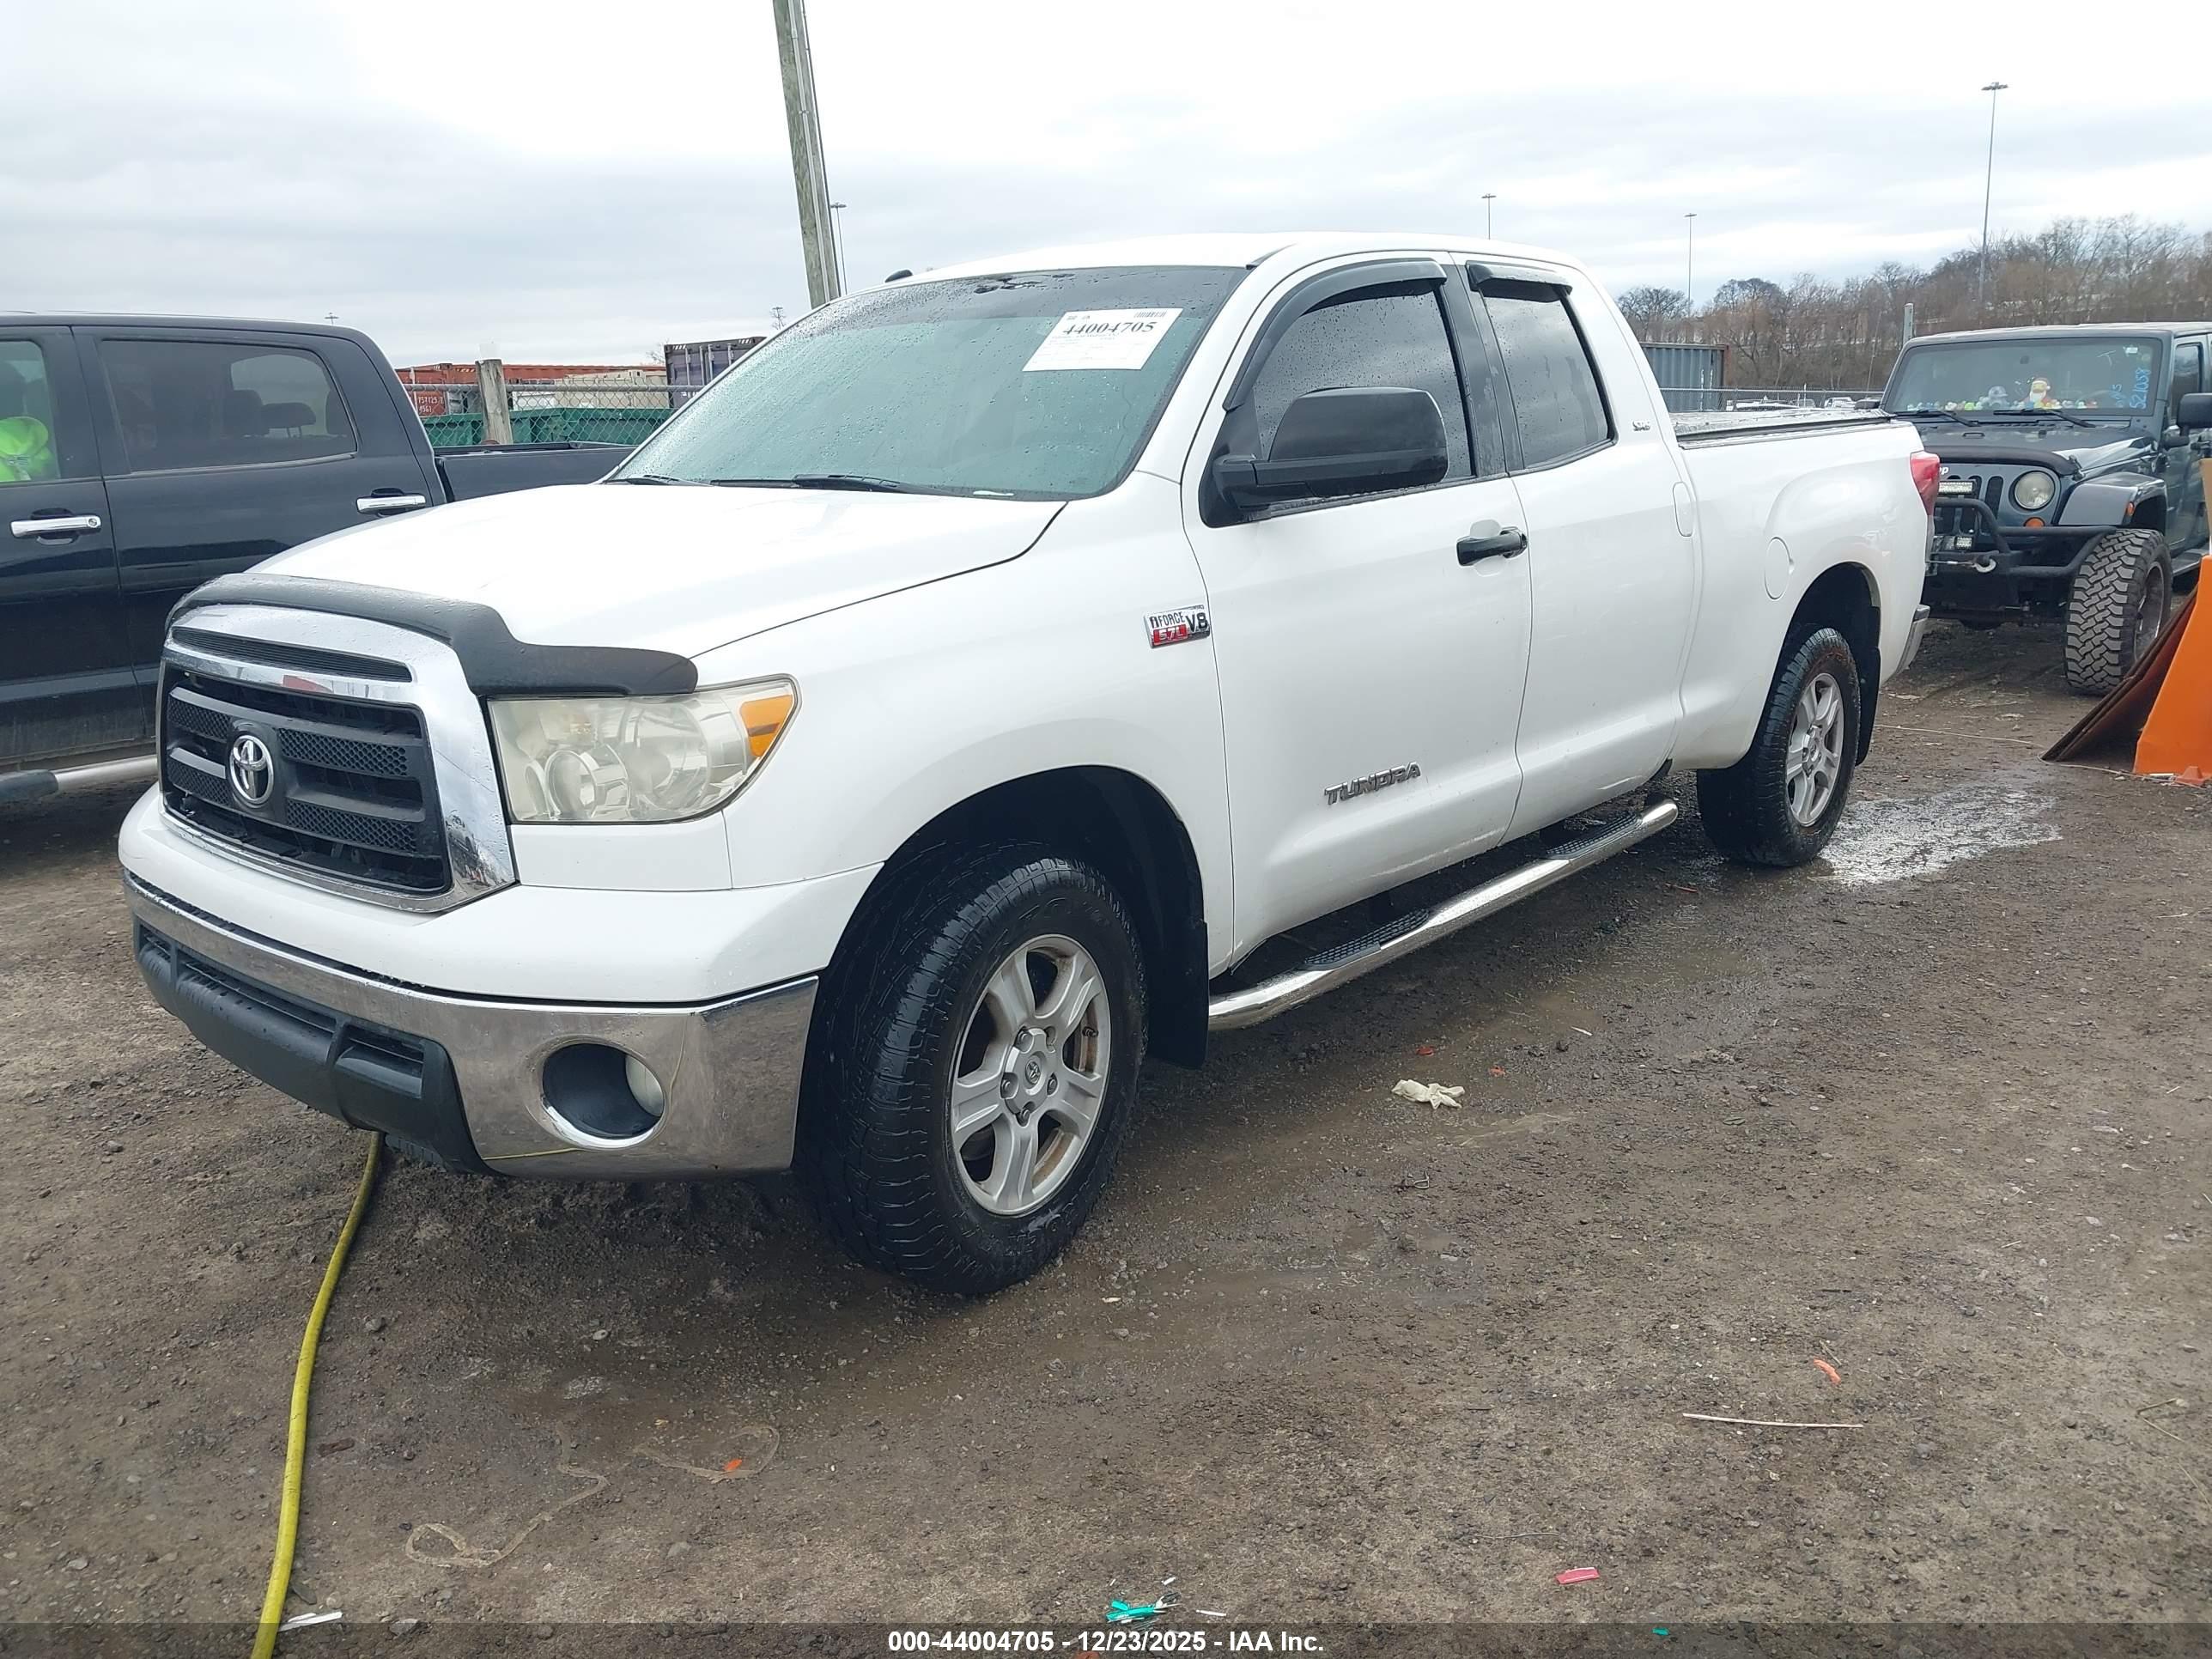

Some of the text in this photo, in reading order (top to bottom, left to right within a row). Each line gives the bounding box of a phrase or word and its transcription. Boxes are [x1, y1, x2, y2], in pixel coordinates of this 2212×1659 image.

[1062, 321, 1158, 335] 44004705
[1185, 611, 1209, 632] V8
[1324, 761, 1421, 805] TUNDRA
